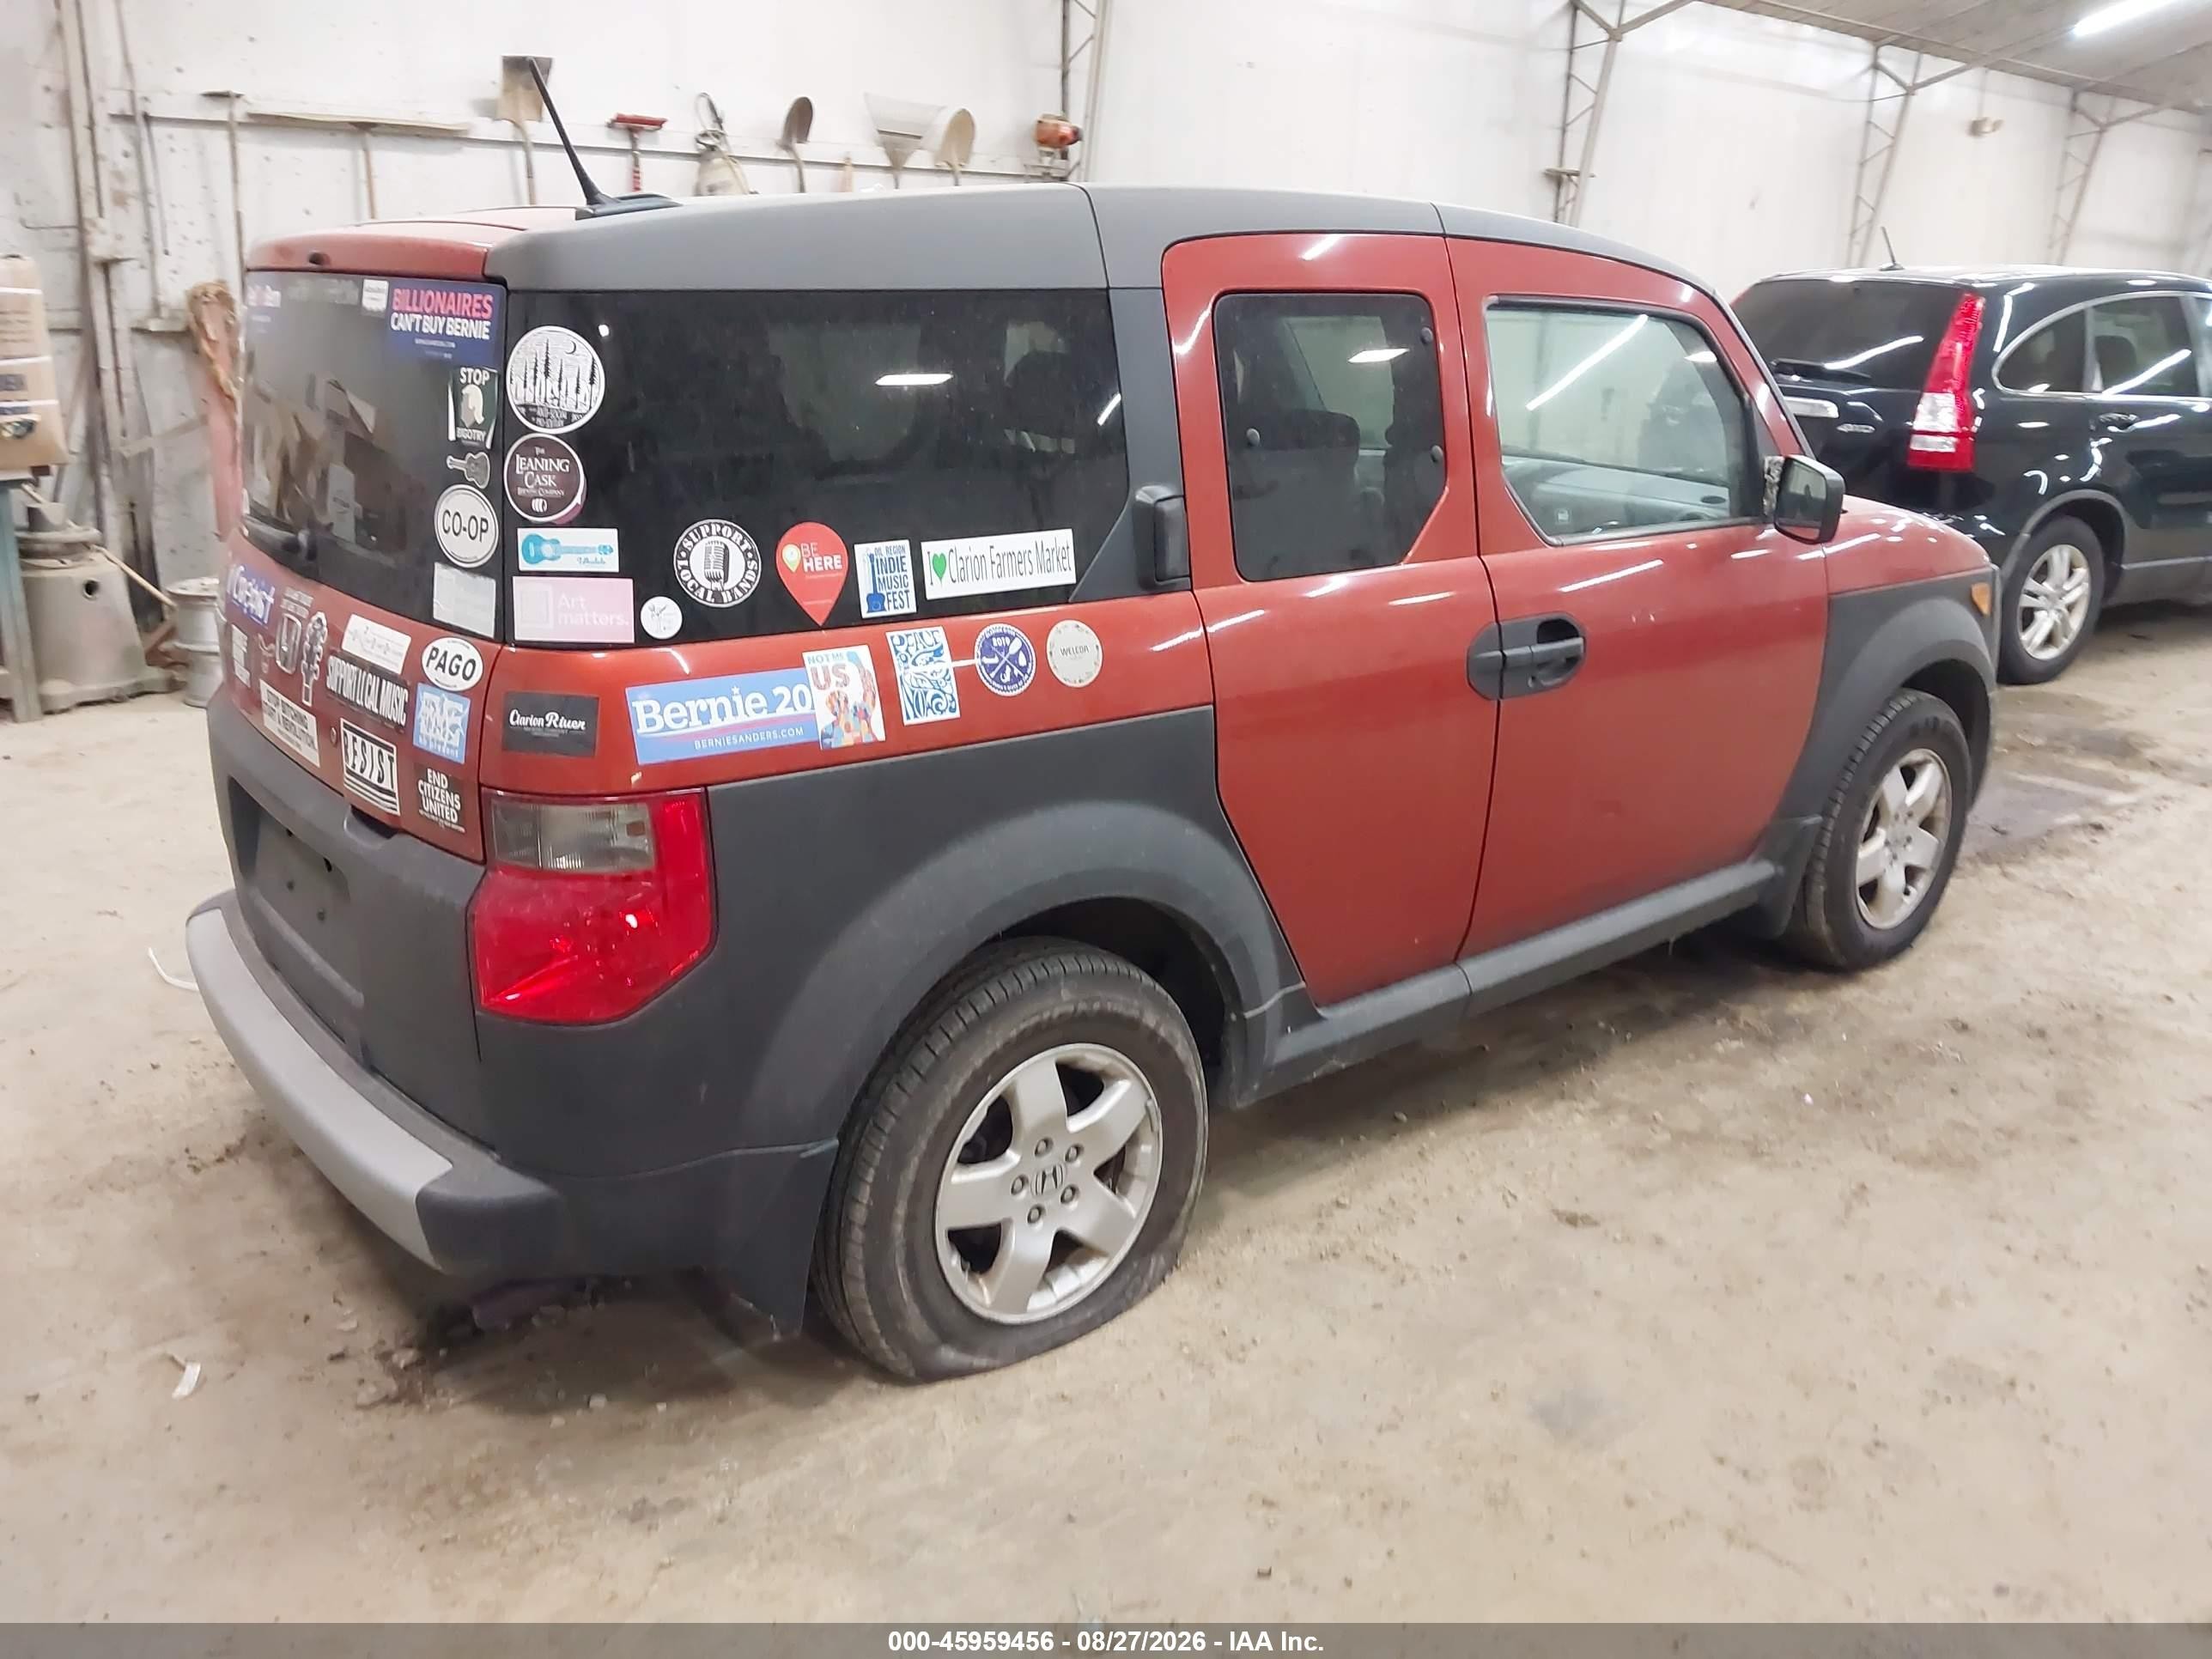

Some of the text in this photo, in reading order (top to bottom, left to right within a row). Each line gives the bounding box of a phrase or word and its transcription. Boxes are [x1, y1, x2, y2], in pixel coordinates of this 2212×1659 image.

[392, 288, 493, 319] BILLIONAIRES
[391, 313, 491, 340] CAN'T BUY BERNIE
[459, 367, 490, 386] STOP
[515, 454, 570, 474] LEANING
[524, 471, 557, 489] CASK
[442, 509, 489, 543] CO-OP
[682, 523, 752, 552] SUPPORT
[800, 542, 819, 558] BE
[885, 544, 906, 556] REGION
[948, 545, 988, 584] Clarion
[989, 544, 1034, 580] Farmers
[1035, 537, 1072, 575] Market
[802, 555, 843, 573] HERE
[876, 556, 908, 575] INDIE
[677, 559, 714, 603] LOCAL
[721, 560, 758, 604] BANDS
[878, 574, 909, 592] MUSIC
[557, 594, 586, 610] Art
[886, 589, 910, 611] FEST
[557, 612, 630, 627] matters.
[425, 647, 477, 681] PAGO
[807, 653, 831, 665] NOT
[810, 663, 850, 690] US
[325, 655, 358, 701] SUPPORT
[379, 679, 409, 727] MUSIC
[509, 709, 586, 731] Clarion River
[631, 685, 768, 734] Bernie
[694, 726, 805, 750] BERNIESANDERS.COM
[344, 730, 395, 792] RESIST
[427, 768, 448, 789] END
[417, 779, 461, 811] CITIZENS
[422, 795, 458, 823] UNITED
